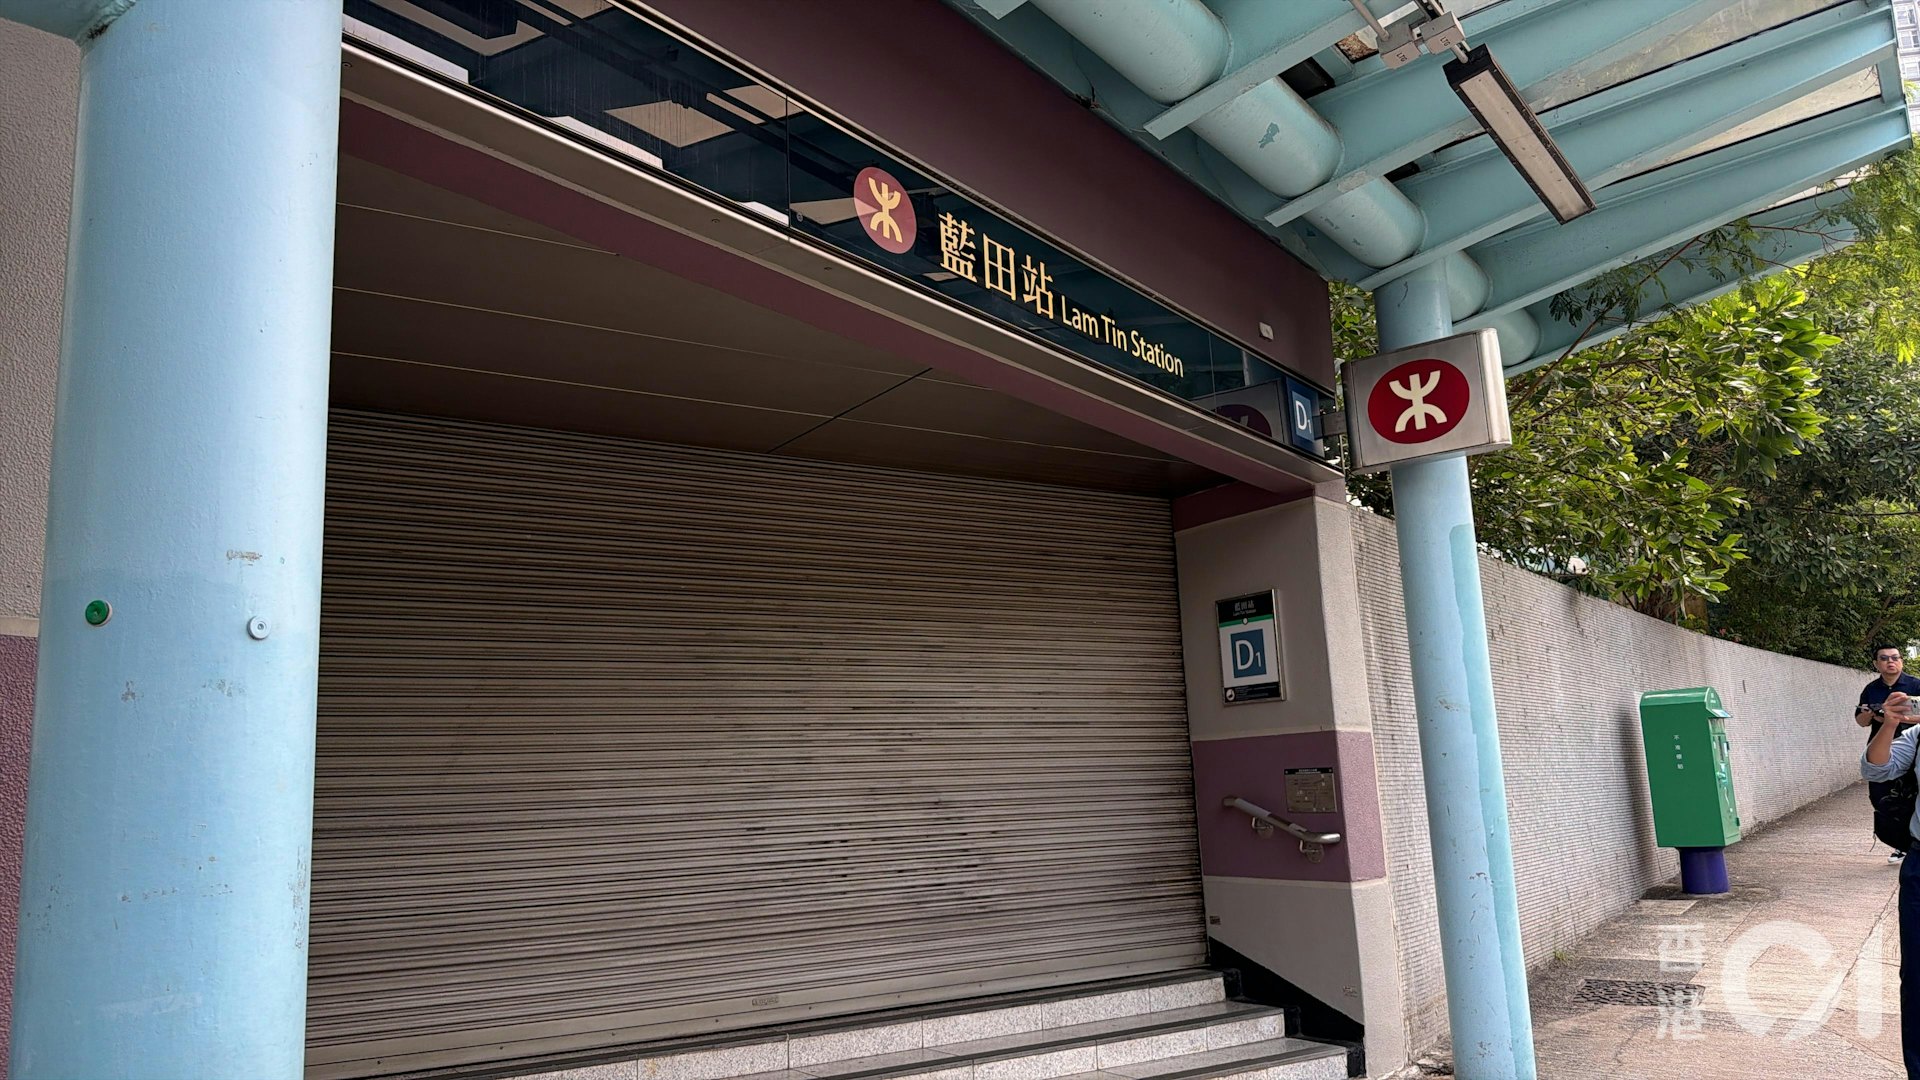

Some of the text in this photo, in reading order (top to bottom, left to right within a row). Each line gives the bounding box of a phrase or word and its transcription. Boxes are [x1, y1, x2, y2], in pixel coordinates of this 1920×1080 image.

[938, 212, 1054, 320] 藍田站
[1061, 295, 1184, 378] Lam Tin Station
[1295, 400, 1312, 434] D1
[1235, 639, 1262, 671] D1
